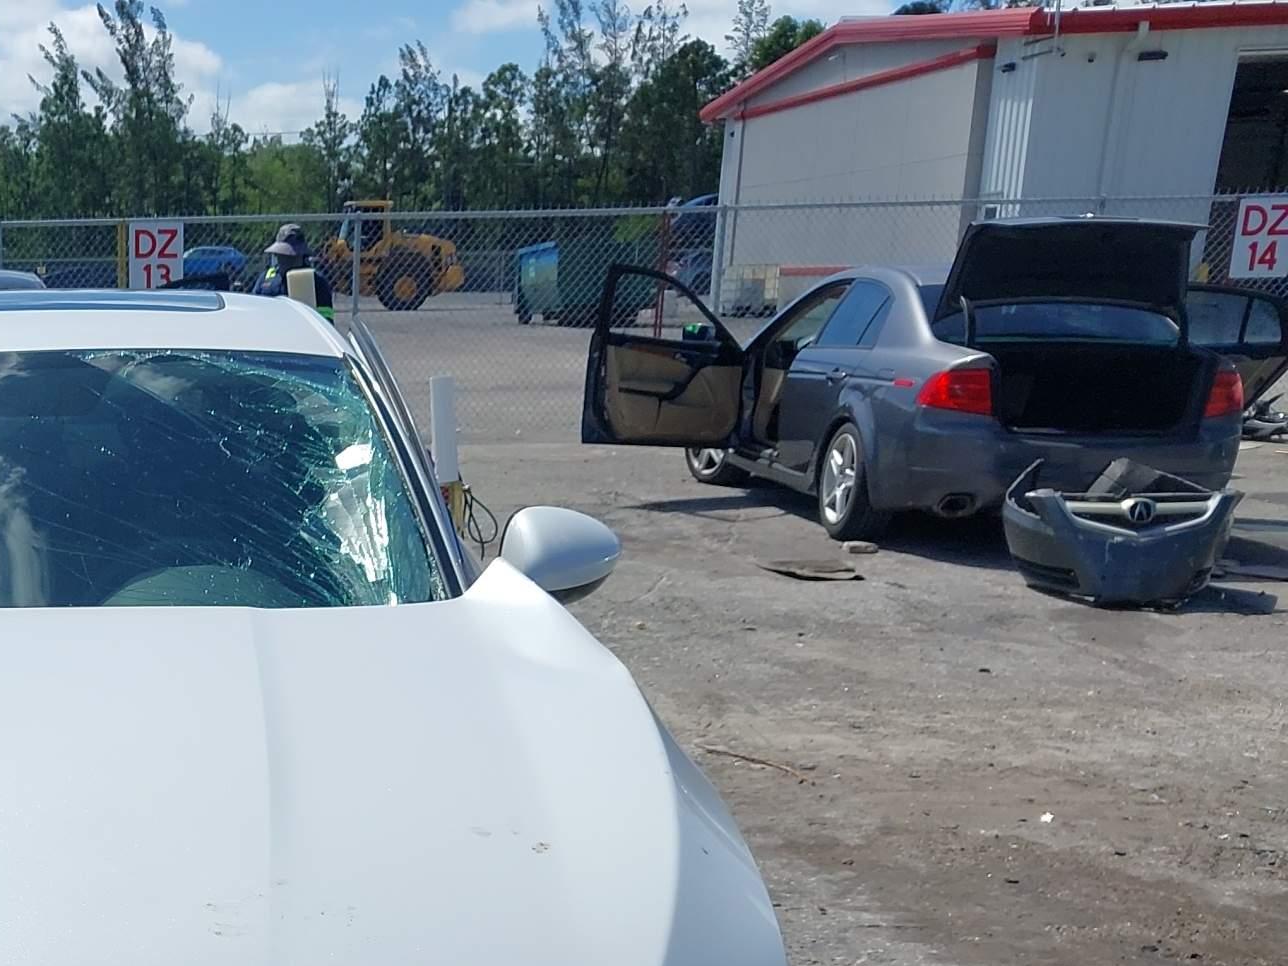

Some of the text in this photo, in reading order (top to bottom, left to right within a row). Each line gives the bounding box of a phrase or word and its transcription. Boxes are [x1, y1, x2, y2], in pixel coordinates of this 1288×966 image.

[1241, 204, 1288, 236] DZ
[134, 228, 178, 259] DZ
[1248, 240, 1277, 271] 14
[143, 263, 171, 288] 13
